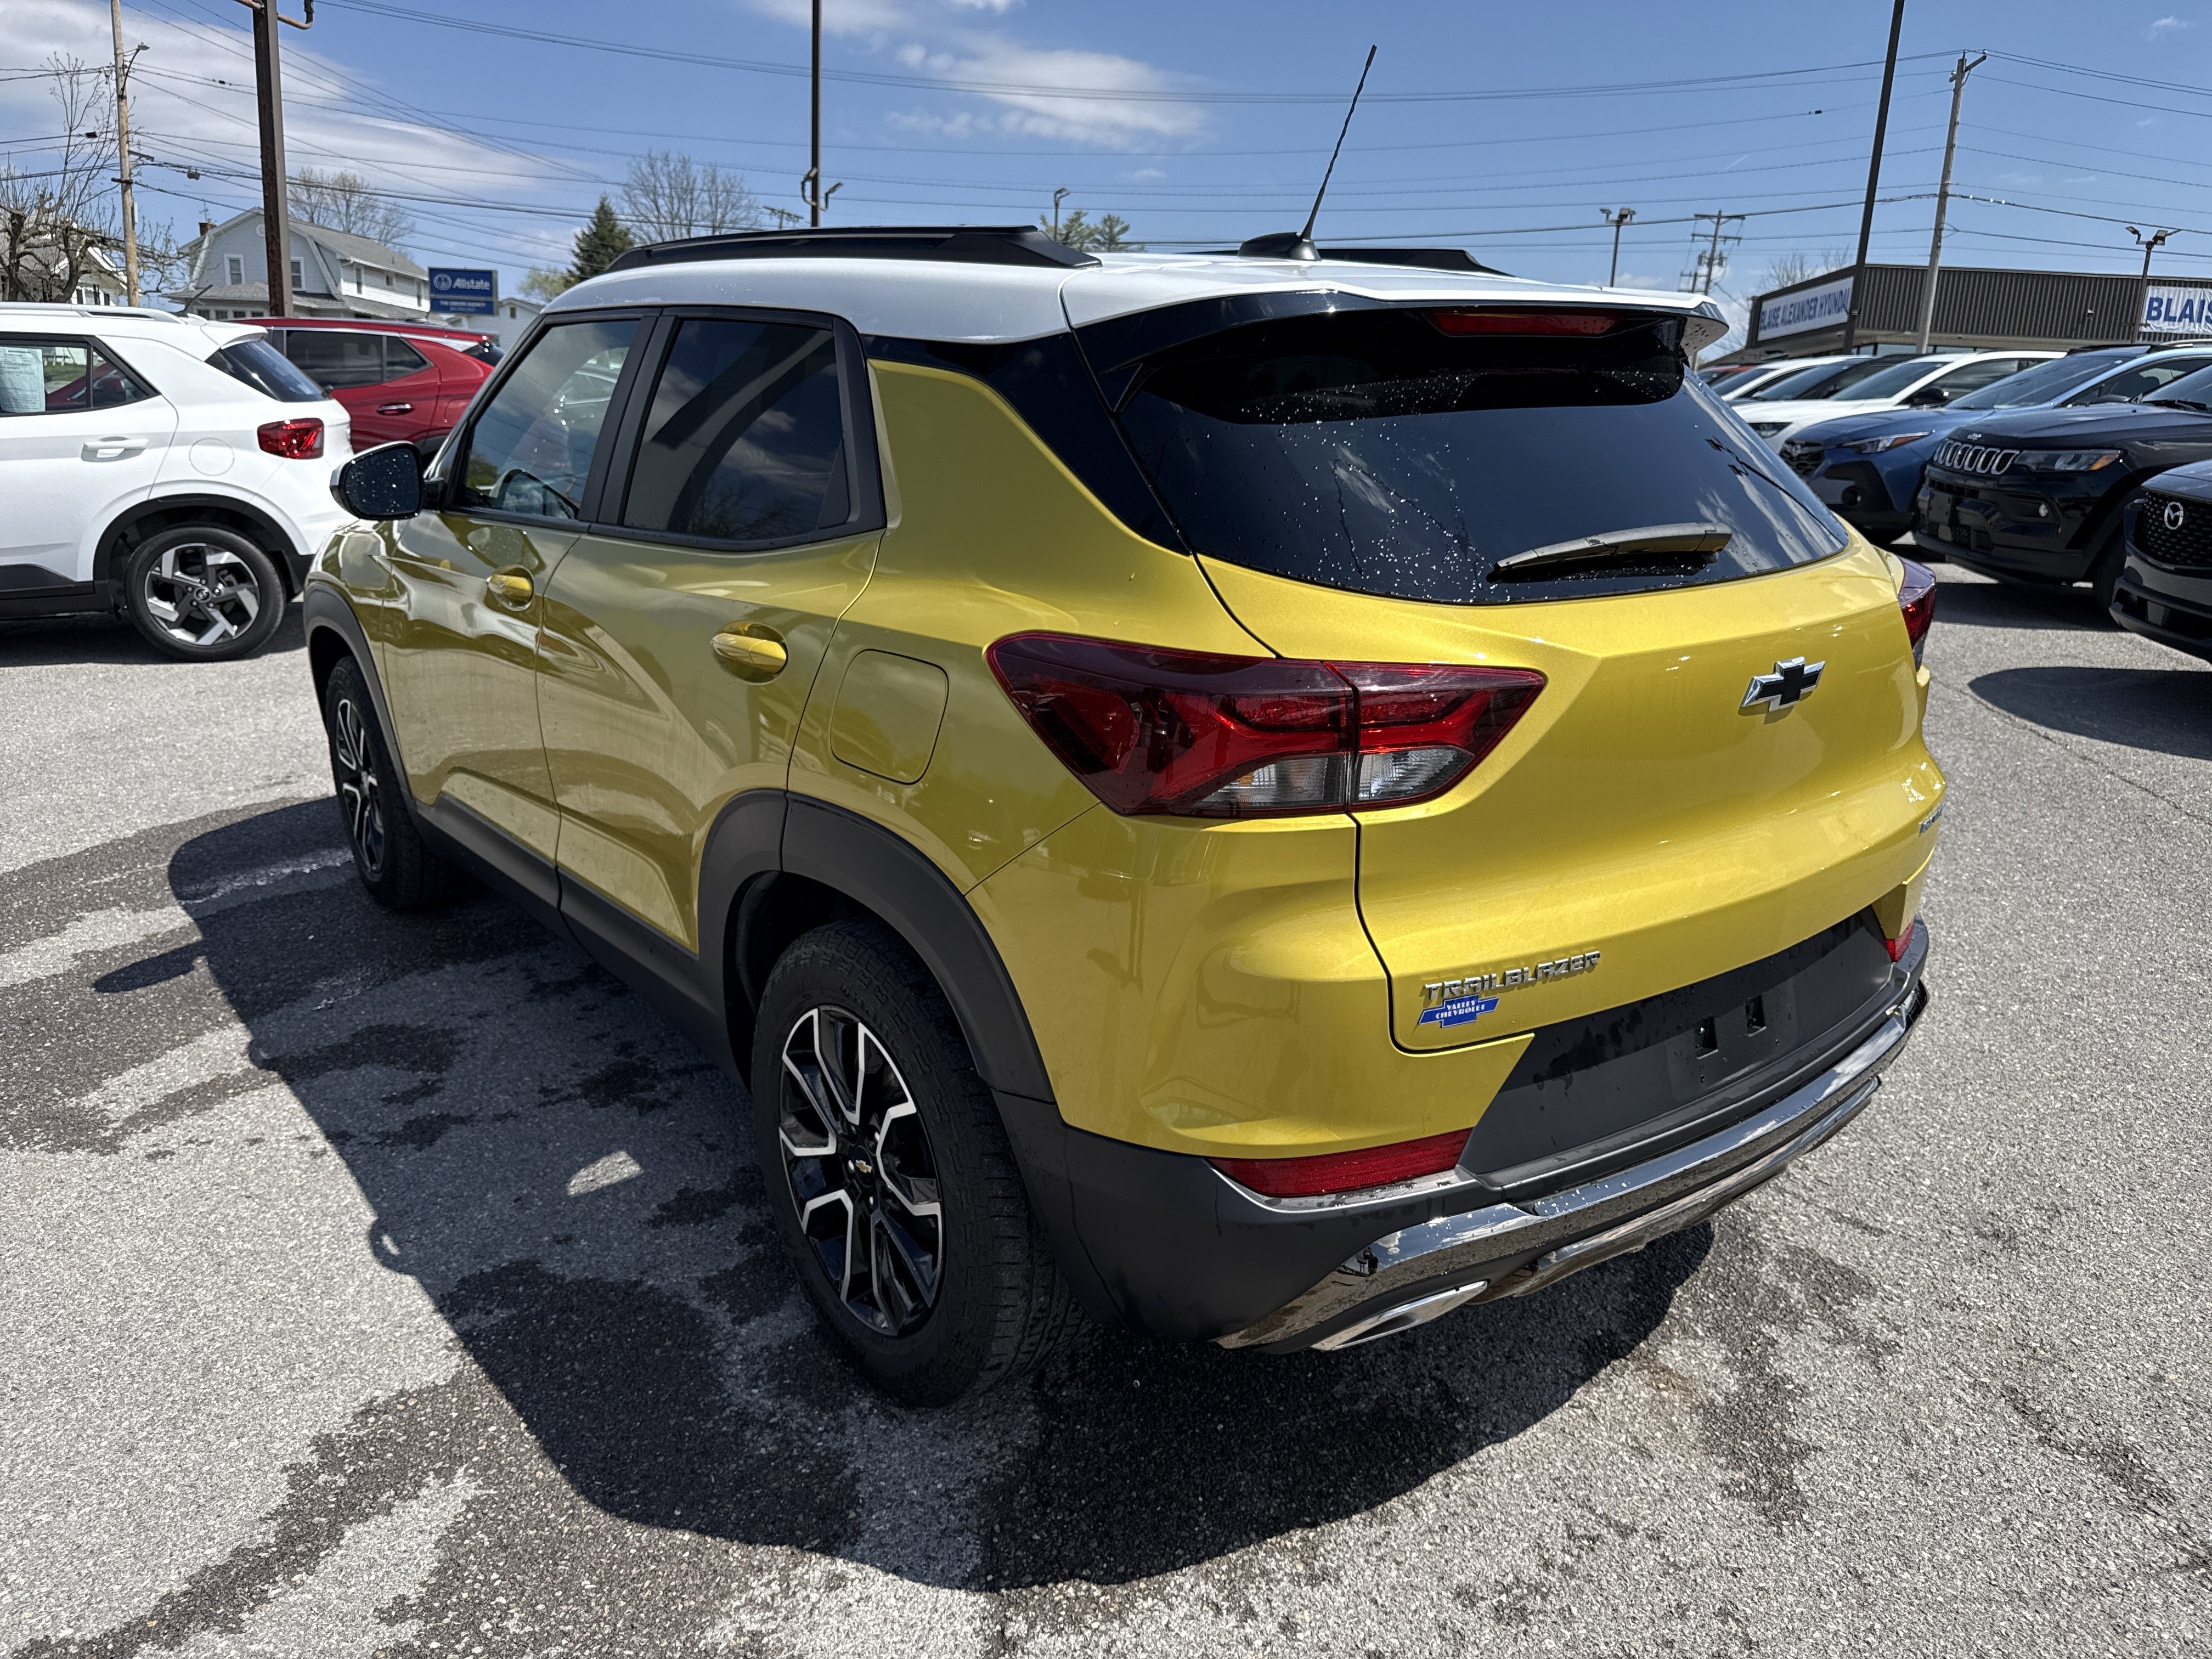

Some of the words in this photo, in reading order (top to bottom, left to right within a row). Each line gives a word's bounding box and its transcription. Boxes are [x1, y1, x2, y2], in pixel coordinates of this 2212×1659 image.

[452, 277, 490, 290] Allstate
[1760, 306, 1781, 331] BLAISE
[1781, 297, 1819, 326] ALEXANDER
[1818, 286, 1850, 319] HYUNDAI
[1425, 951, 1600, 1000] TRAILBLAZER
[1435, 1004, 1486, 1019] CHEVROLET
[1447, 1000, 1476, 1011] VALLEY
